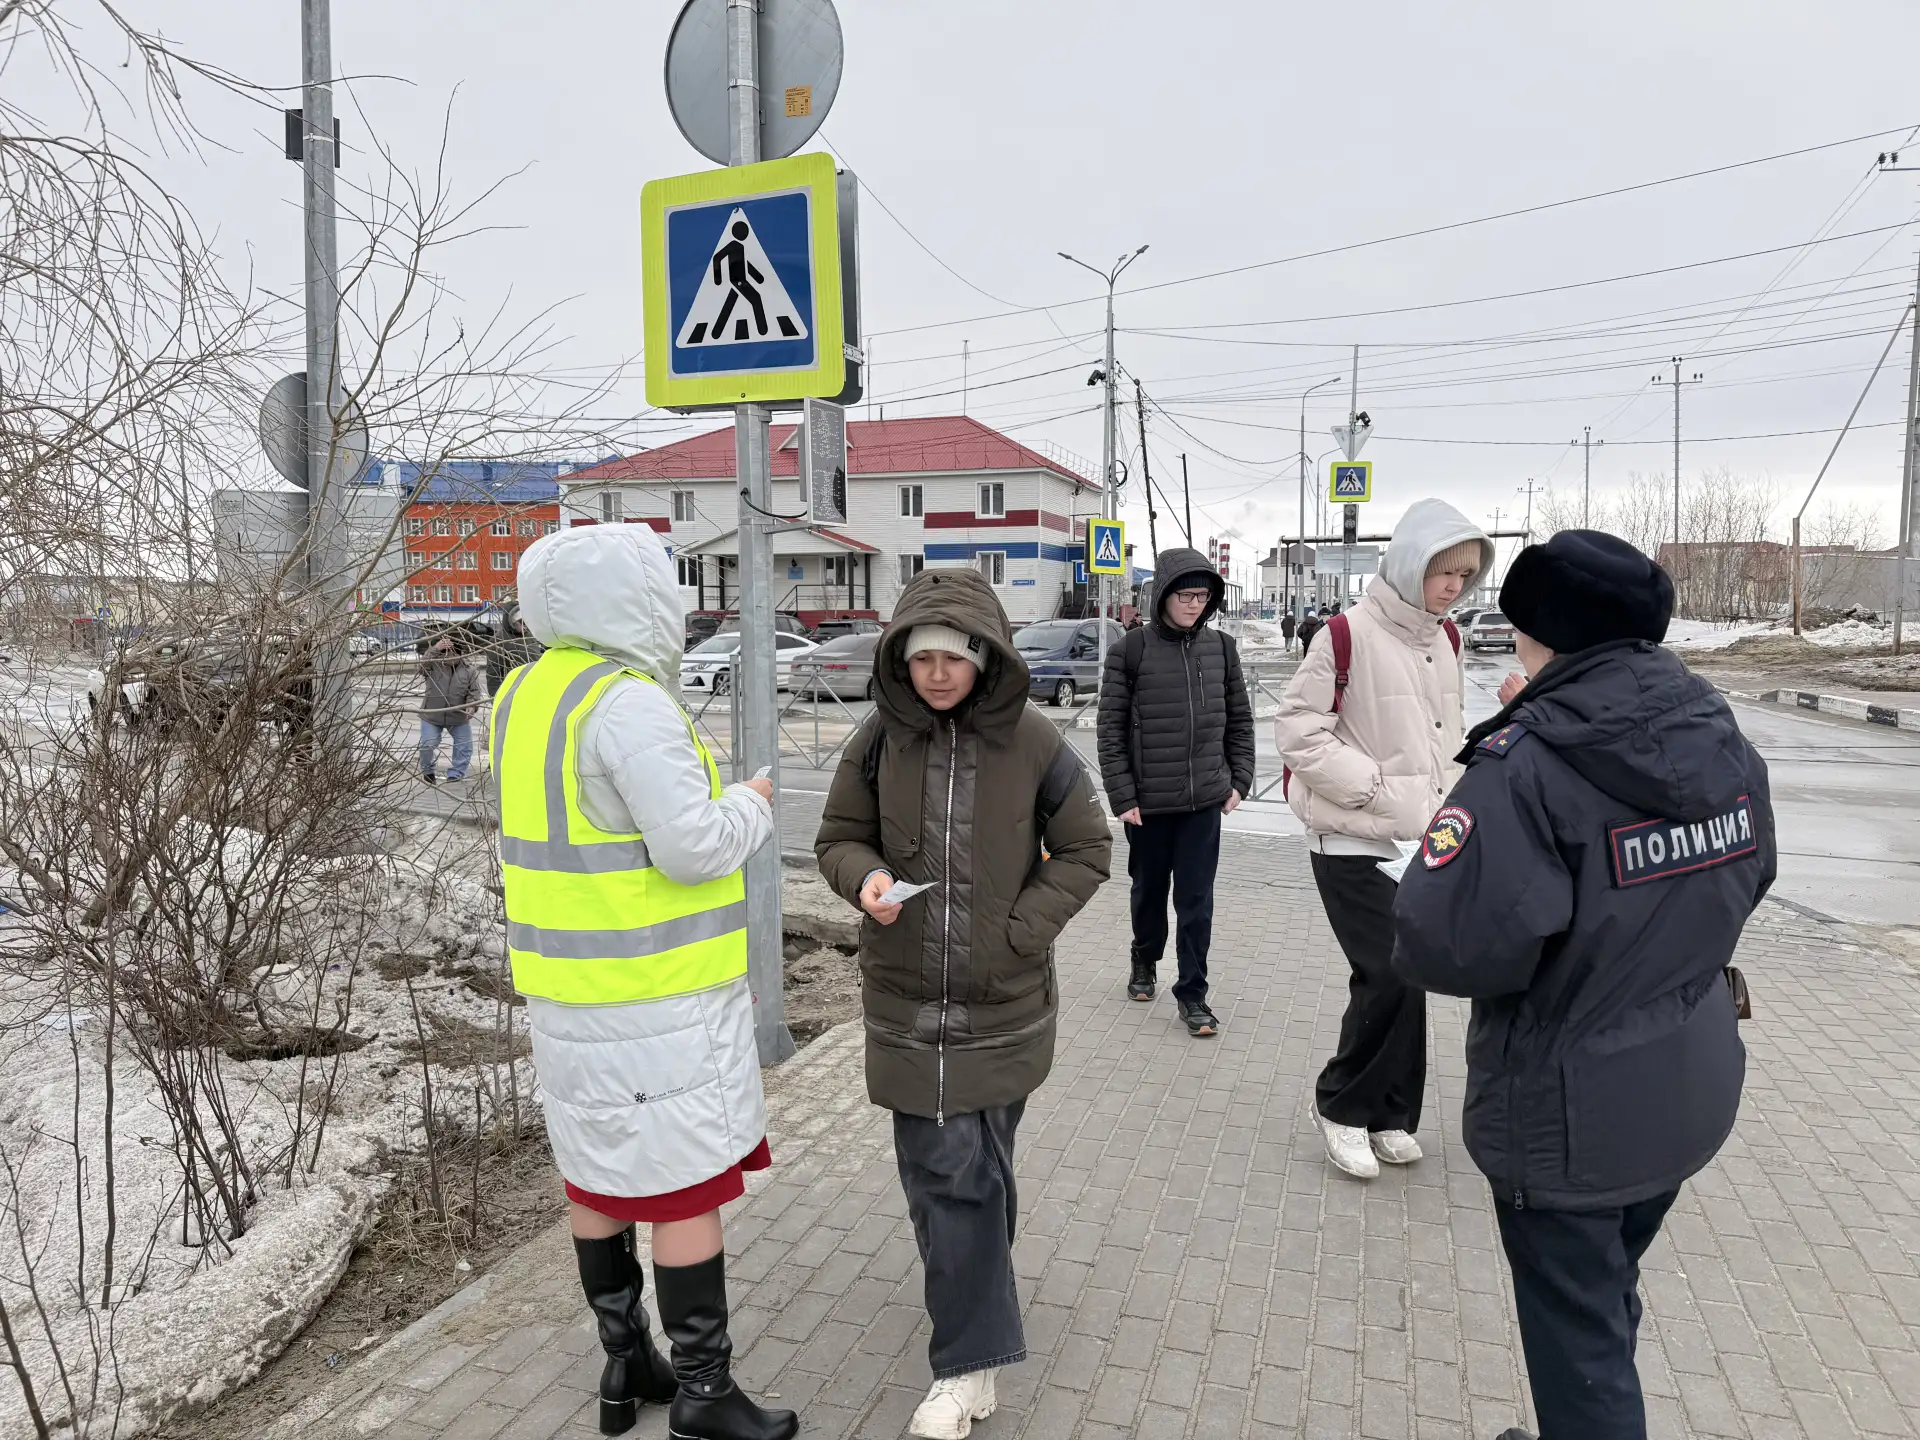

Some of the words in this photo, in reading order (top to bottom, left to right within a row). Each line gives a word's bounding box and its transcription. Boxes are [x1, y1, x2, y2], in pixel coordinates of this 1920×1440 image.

[1437, 818, 1463, 835] РОССИЯ
[1438, 808, 1470, 828] ПОЛИЦИЯ
[1624, 808, 1751, 871] ПОЛИЦИЯ
